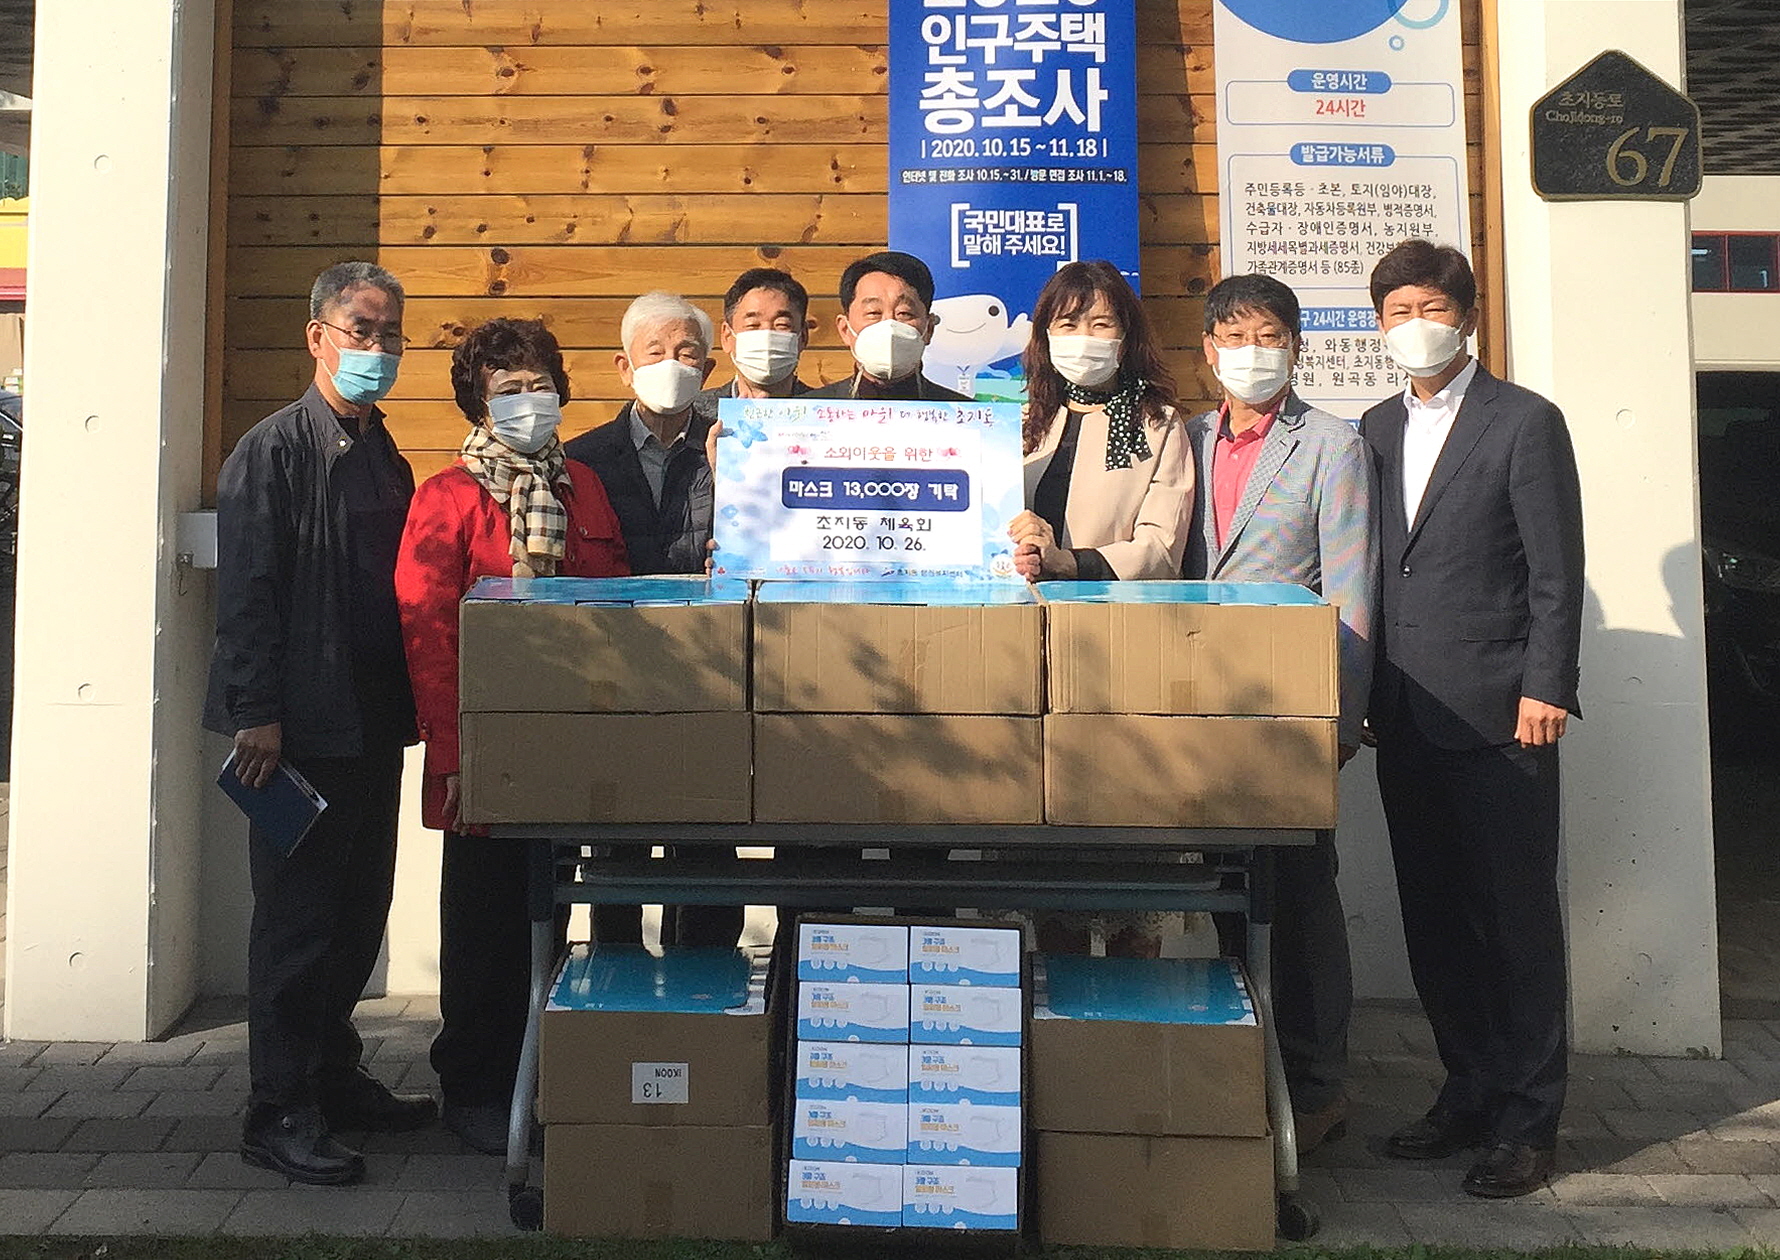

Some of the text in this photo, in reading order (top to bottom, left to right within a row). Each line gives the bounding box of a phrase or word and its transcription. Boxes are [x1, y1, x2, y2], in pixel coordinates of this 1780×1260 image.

[921, 13, 1106, 64] 인구주택
[1310, 72, 1368, 91] 운영시간
[919, 67, 1108, 133] 총조사
[1316, 99, 1366, 117] 24시간
[1558, 91, 1624, 109] 초지동로
[1301, 144, 1385, 164] 발급가능서류
[1606, 126, 1689, 187] 67
[902, 170, 926, 183] 인터넷
[958, 168, 974, 182] 조사
[1031, 169, 1047, 182] 방문
[1067, 169, 1084, 182] 조사
[1351, 183, 1437, 199] 토지(임야)대장,
[1246, 201, 1437, 218] 건축물대장, 자동차등록원부, 병적증명서,
[963, 210, 1066, 235] 국민대표로
[1384, 222, 1439, 238] 농지원부,
[963, 235, 1066, 256] 말해 주세요!
[1247, 260, 1364, 275] 가족관계증명서 등 (85종)
[1313, 309, 1345, 328] 24시간
[1332, 372, 1377, 387] 원곡동
[956, 406, 995, 427] 초지동
[824, 446, 933, 462] 소외이웃을 위한
[788, 480, 959, 501] 마스크 13,000장 기탁
[816, 516, 932, 532] 초지동 체육회
[822, 535, 926, 551] 2020. 10. 26.
[642, 1082, 662, 1099] 13
